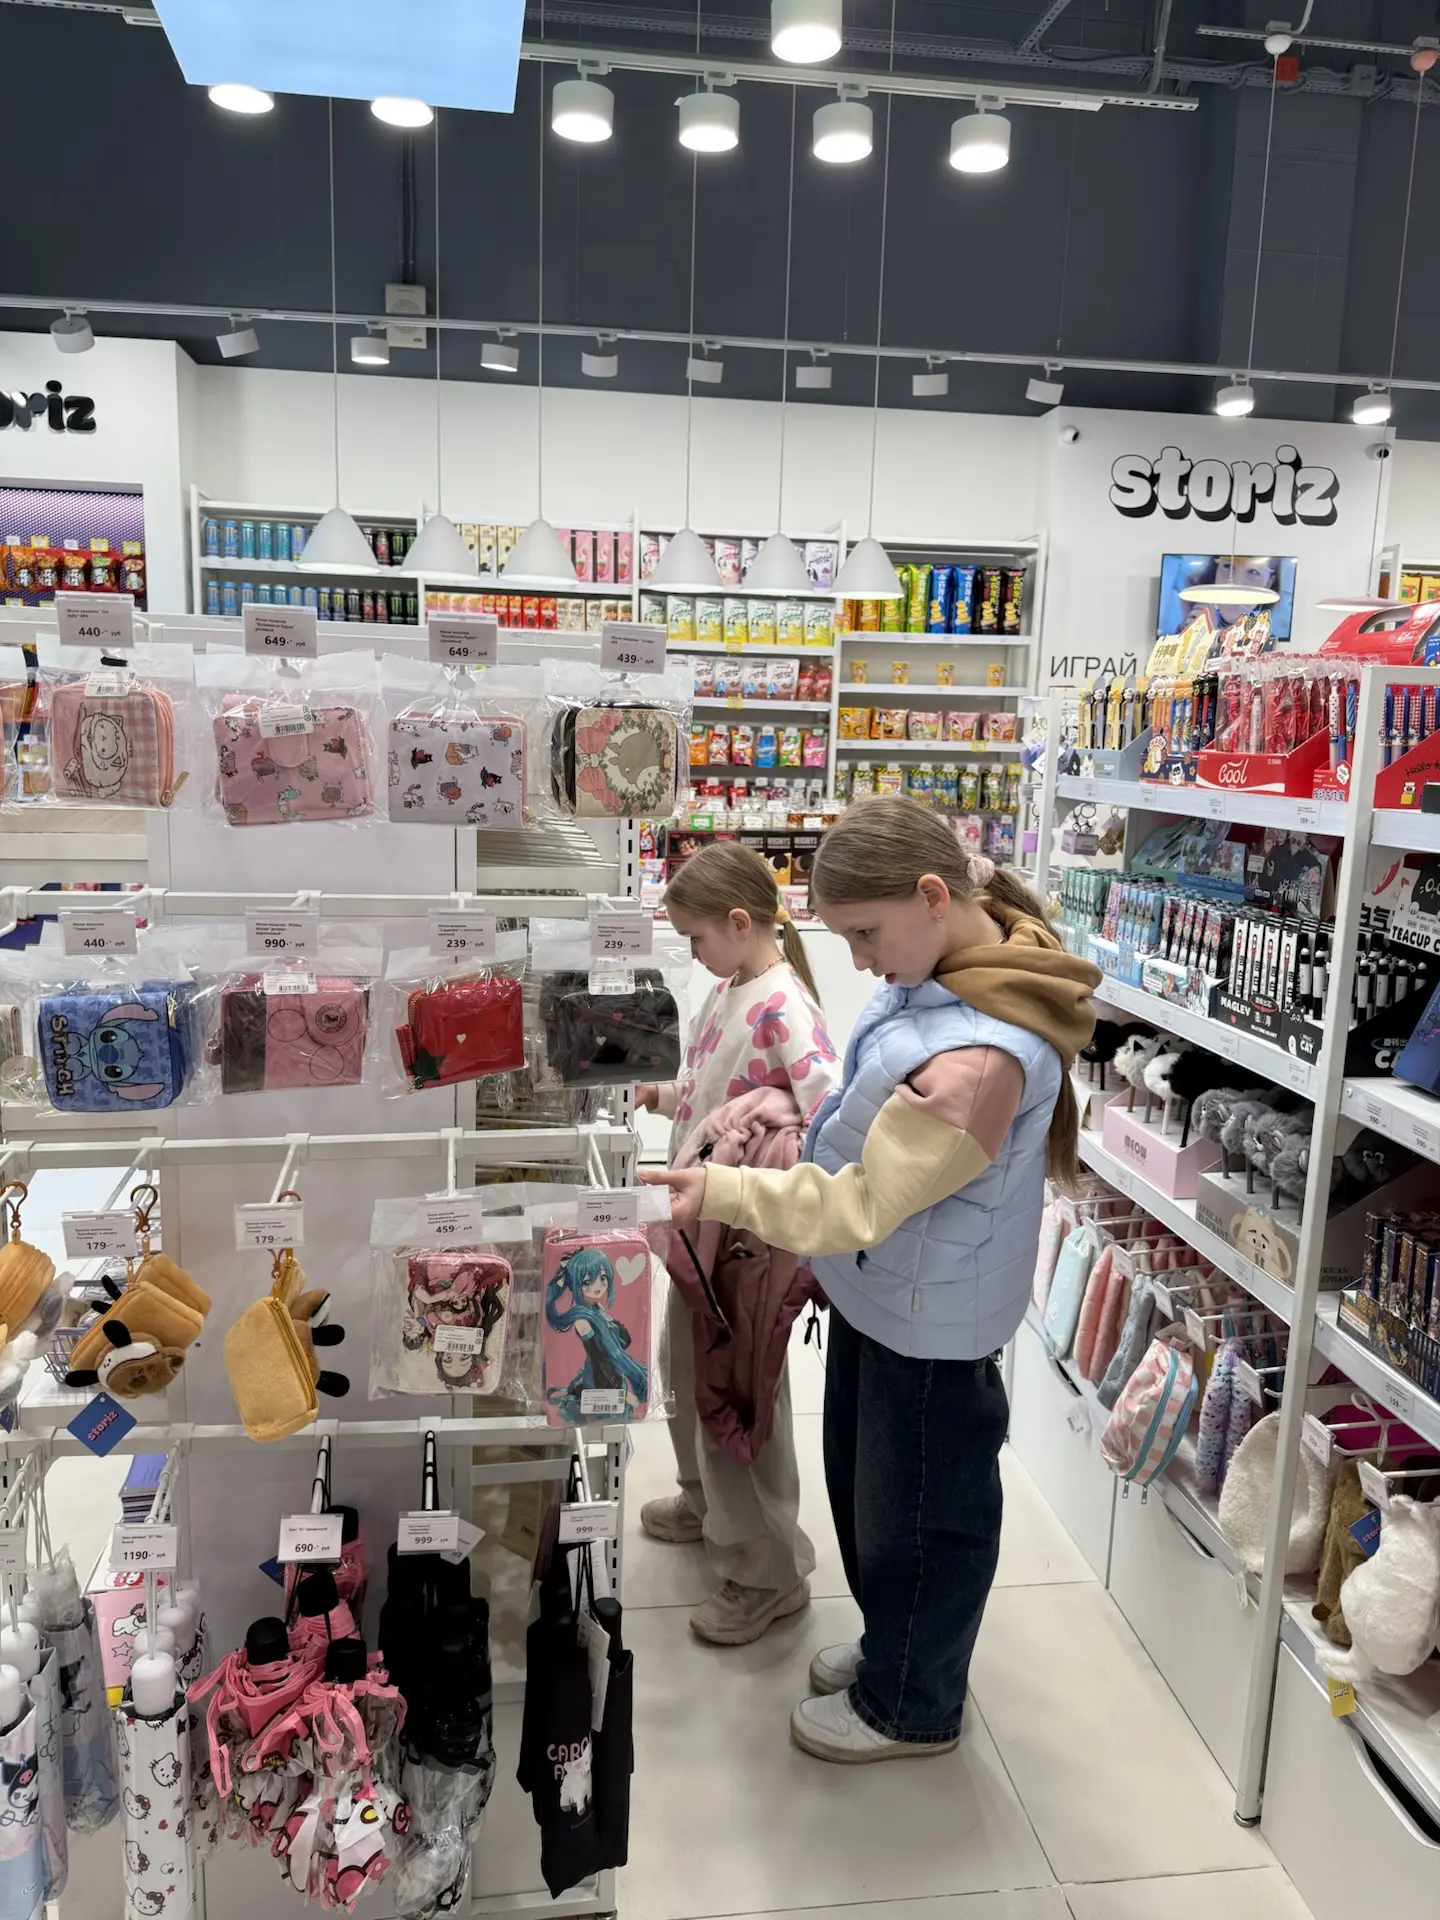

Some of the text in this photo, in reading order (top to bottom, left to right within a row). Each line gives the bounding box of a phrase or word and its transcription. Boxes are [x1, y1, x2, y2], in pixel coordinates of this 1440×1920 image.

[1109, 444, 1340, 526] storiz
[1050, 652, 1138, 678] ИГРАЙ
[1218, 758, 1250, 784] Cool
[1392, 926, 1431, 949] TEACUP
[1300, 1040, 1314, 1055] CAT
[1124, 1134, 1147, 1159] MEOW
[88, 1410, 119, 1441] storiz
[1362, 1524, 1382, 1544] stor
